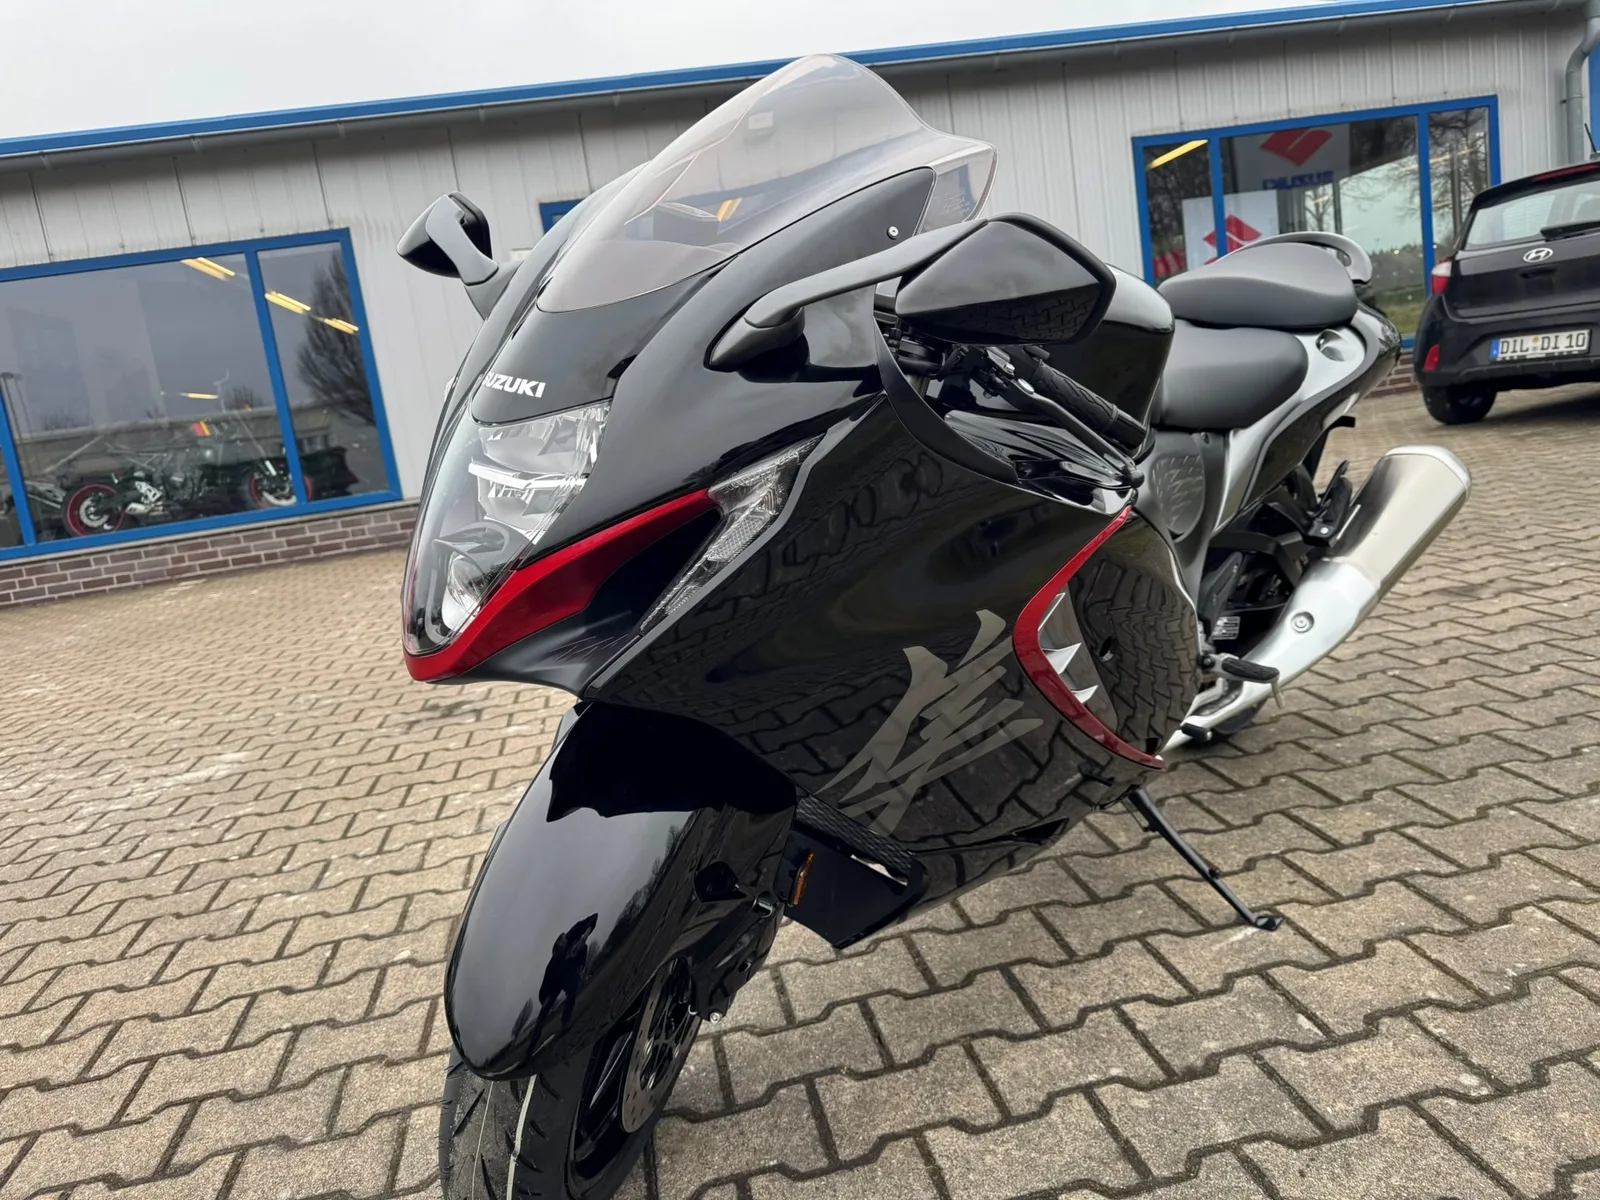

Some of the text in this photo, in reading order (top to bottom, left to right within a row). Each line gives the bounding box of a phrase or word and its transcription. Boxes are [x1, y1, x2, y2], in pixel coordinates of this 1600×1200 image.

[1499, 332, 1586, 355] DIL DI 10
